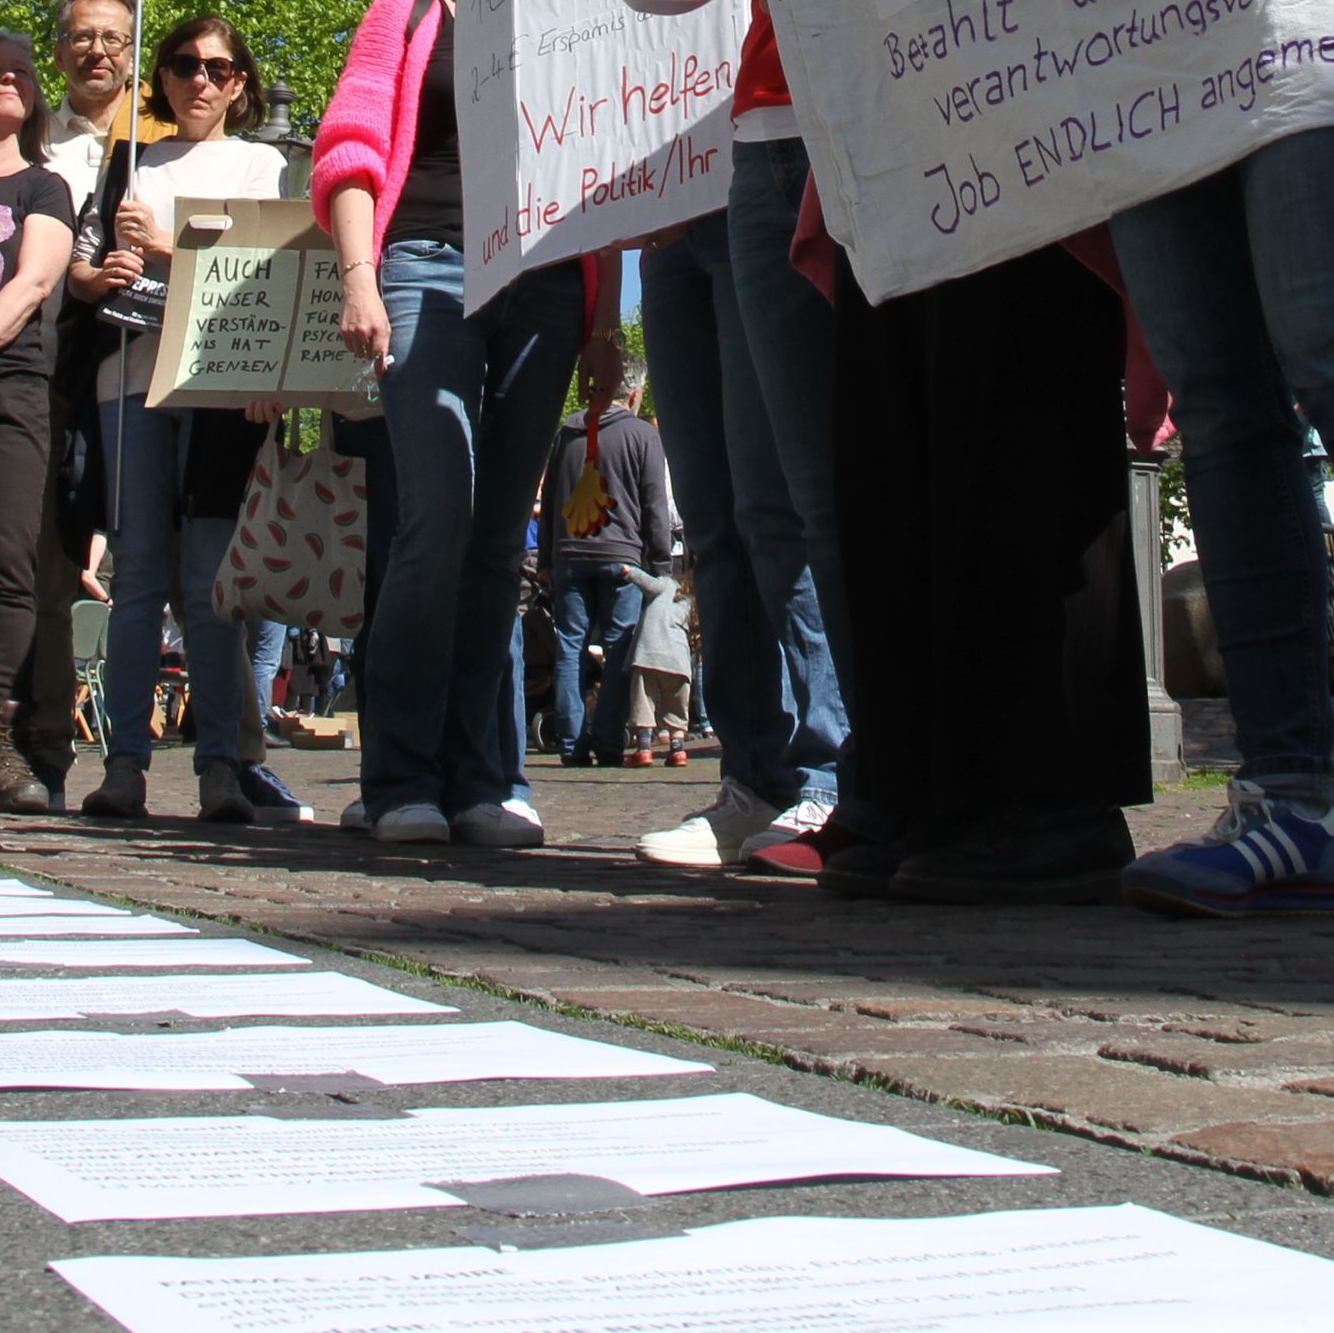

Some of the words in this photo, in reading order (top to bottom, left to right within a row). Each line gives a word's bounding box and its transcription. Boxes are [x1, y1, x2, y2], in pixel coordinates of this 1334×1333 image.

[521, 86, 609, 154] Wir
[622, 52, 733, 126] helfen
[924, 155, 1001, 235] Job
[1015, 83, 1181, 187] ENDLICH
[481, 206, 509, 265] und
[516, 183, 565, 237] die
[205, 256, 272, 283] AUCH
[314, 261, 340, 280] FA
[201, 291, 270, 307] UNSER
[196, 315, 286, 333] VERSTÄND-
[305, 311, 339, 326] FÜR
[191, 339, 216, 351] NIS
[231, 338, 271, 351] HAT
[188, 360, 279, 376] GRENZEN
[300, 350, 347, 362] RAPIE
